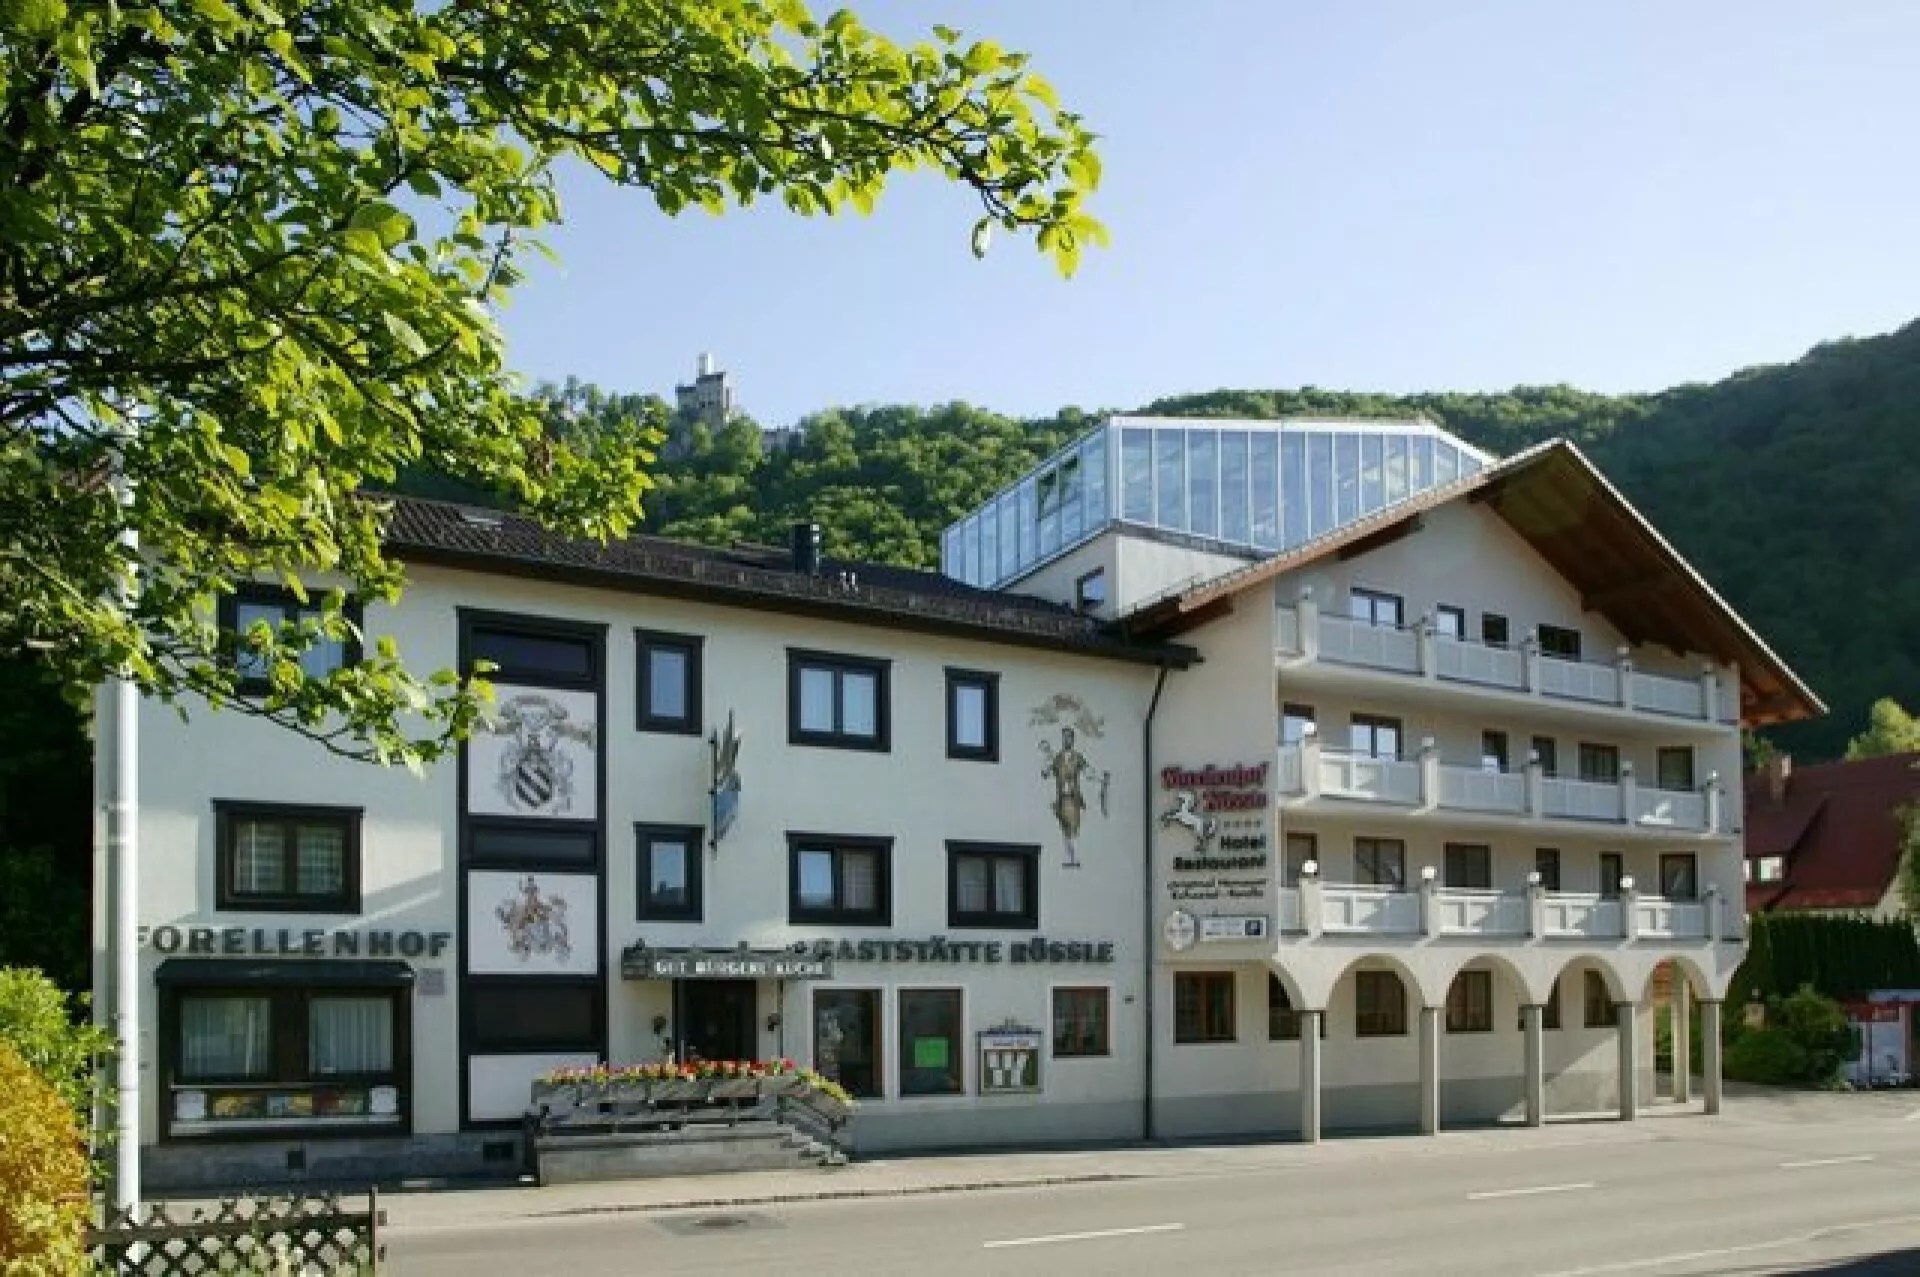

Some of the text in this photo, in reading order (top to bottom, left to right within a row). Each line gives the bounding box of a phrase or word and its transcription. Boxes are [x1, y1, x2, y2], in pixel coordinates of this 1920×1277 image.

[1220, 835, 1267, 850] Hotel
[1173, 855, 1267, 871] Restaurant
[813, 935, 1114, 963] GASTSTÄTTE RÖSSLE
